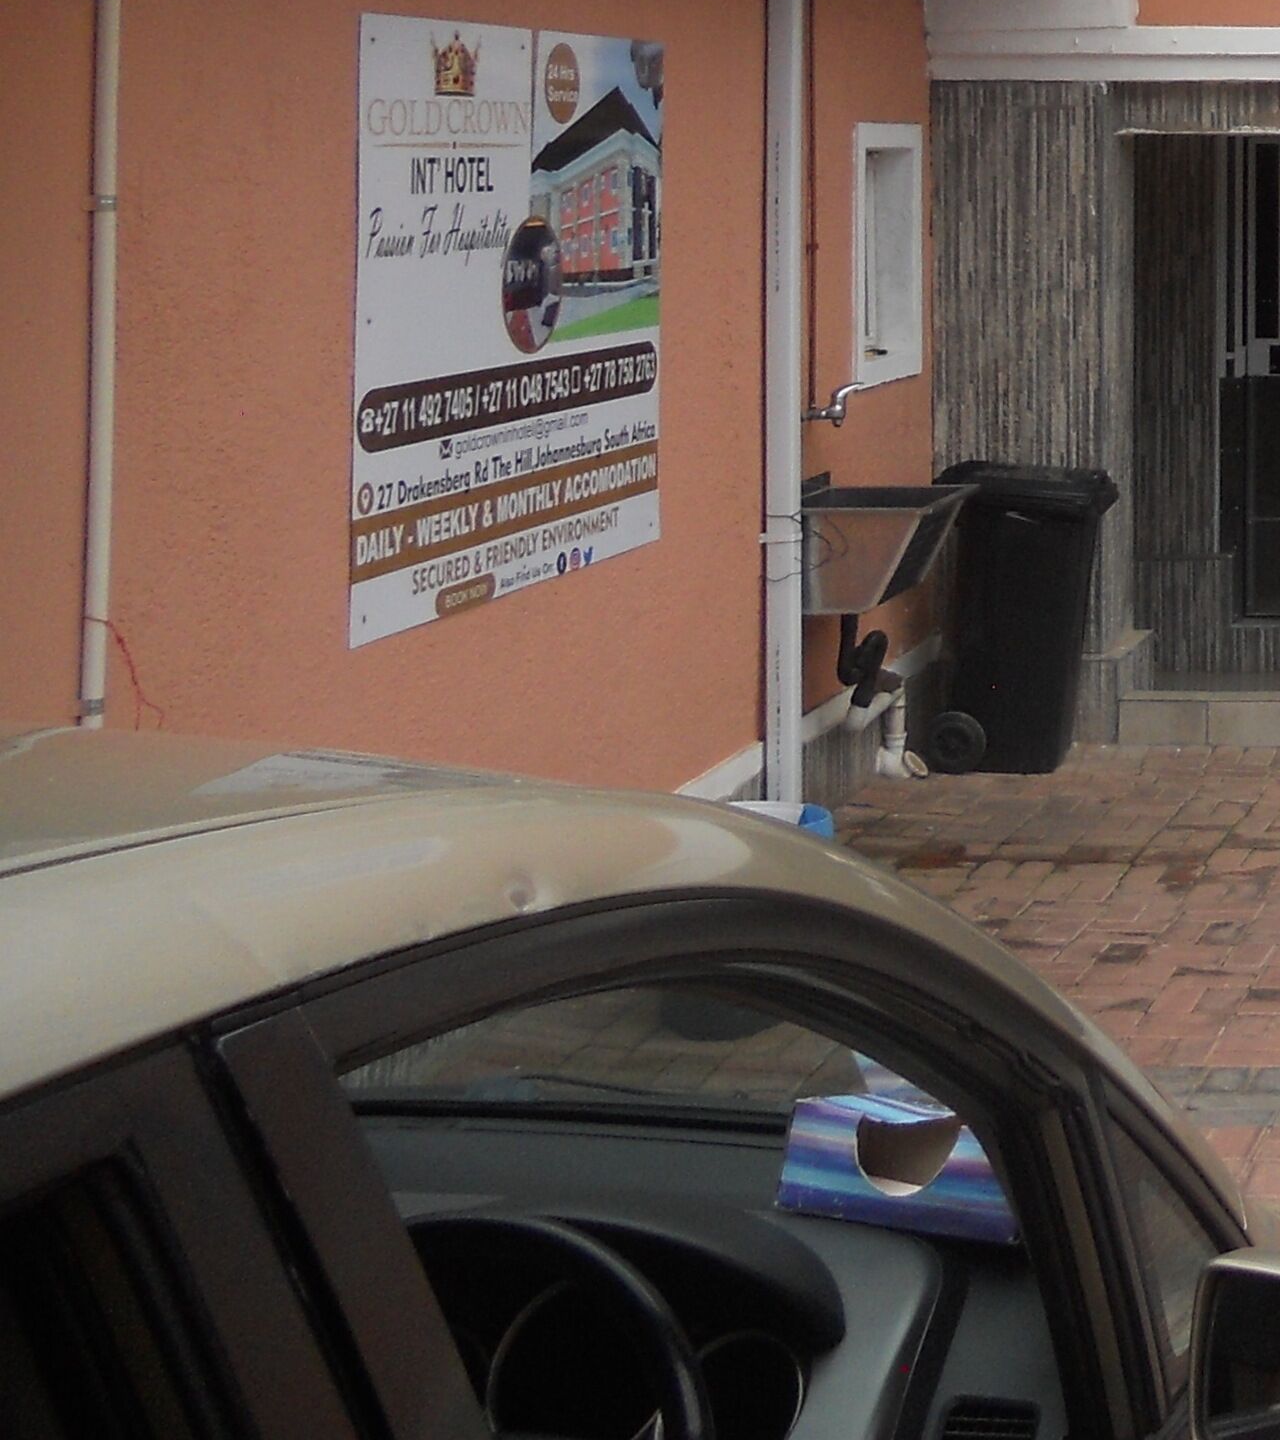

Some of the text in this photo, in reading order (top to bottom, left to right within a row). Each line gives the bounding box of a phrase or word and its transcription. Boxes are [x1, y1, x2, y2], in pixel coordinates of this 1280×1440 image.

[444, 157, 494, 193] HOTEL
[365, 202, 512, 266] Passion For Hospitality
[375, 401, 399, 436] +27
[402, 397, 415, 431] 11
[419, 392, 442, 427] 492
[445, 386, 473, 422] 7405
[482, 381, 503, 414] +27
[506, 378, 518, 410] 11
[520, 373, 543, 407] 048
[545, 368, 570, 401] 7543
[584, 362, 603, 393] +27
[605, 359, 616, 389] 78
[378, 483, 394, 510] 27
[398, 468, 471, 505] Drakensberg
[474, 458, 489, 484] Rd
[492, 455, 511, 478] The
[604, 425, 629, 450] South
[631, 421, 656, 443] Africa
[356, 524, 405, 566] DAILY
[416, 503, 479, 547] WEEKLY
[482, 499, 493, 528] &
[497, 479, 562, 523] MONTHLY
[564, 453, 657, 503] ACCOMODATION
[412, 507, 619, 596] SECURED & FRIENDLY ENVIRONMENT
[445, 590, 468, 608] BOOK
